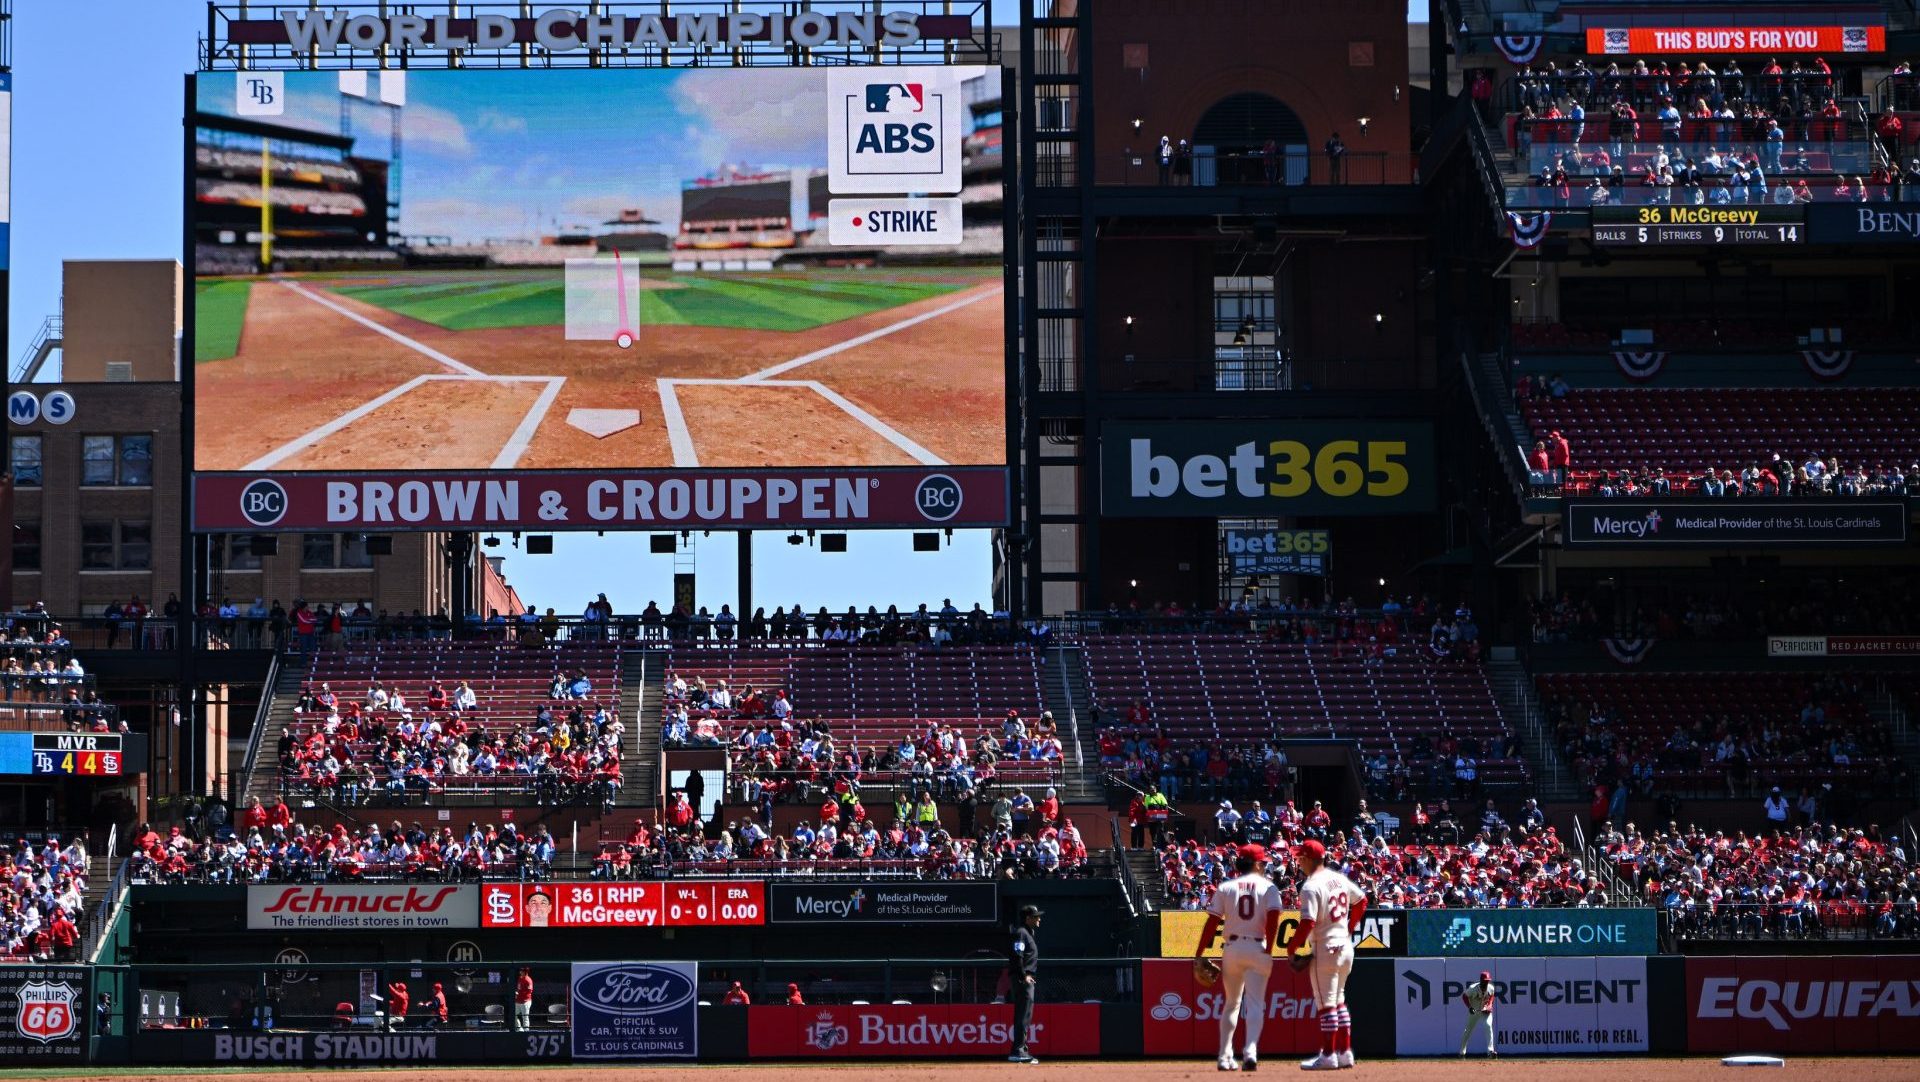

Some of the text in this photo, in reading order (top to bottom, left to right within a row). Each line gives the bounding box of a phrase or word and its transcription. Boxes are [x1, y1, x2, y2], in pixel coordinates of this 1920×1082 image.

[281, 9, 920, 51] WORLD CHAMPIONS
[1654, 30, 1818, 50] THIS BUD'S FOR YOU
[247, 79, 274, 105] TB
[856, 122, 935, 154] ABS
[868, 210, 937, 233] STRIKE
[1639, 207, 1758, 225] 36 McGreevy
[1596, 227, 1797, 243] BALLS 5 STRIKES 9 TOTAL 14
[1130, 438, 1409, 498] bet365
[327, 480, 519, 522] BROWN
[537, 490, 569, 521] &
[1594, 516, 1647, 538] Mercy
[1676, 516, 1881, 529] Medical Provider of the St. Louis Cardinals
[1227, 531, 1329, 554] bet365
[1263, 555, 1293, 564] BRIDGE
[1831, 642, 1850, 650] RED
[1853, 641, 1891, 650] JACKET
[57, 736, 97, 750] MVR
[33, 752, 54, 773] TB
[61, 752, 74, 774] 4
[84, 752, 97, 774] 4
[571, 887, 645, 903] 36 RHP
[678, 889, 698, 900] W-L
[727, 889, 748, 899] ERA
[877, 893, 948, 902] Medical Provider
[563, 905, 657, 926] McGreevy
[721, 904, 758, 919] 0.00
[796, 896, 851, 917] Mercy
[877, 905, 886, 914] of
[887, 905, 901, 914] the
[934, 904, 972, 914] Cardinals
[1327, 892, 1348, 922] 29
[272, 914, 449, 927] The friendliest stores in town
[26, 991, 68, 1001] PHILLIPS
[598, 971, 670, 1003] Ford
[1443, 980, 1641, 1005] PRFICIENT
[28, 1006, 64, 1029] 66
[613, 1018, 656, 1026] OFFICIAL
[591, 1027, 678, 1036] CAR, TRUCK & SUV
[1512, 1030, 1584, 1045] CONSULTING.
[1587, 1030, 1609, 1044] FOR
[1612, 1029, 1643, 1044] REAL.
[215, 1034, 437, 1060] BUSCH STADIUM
[584, 1041, 684, 1051] ST. LOUIS CARDINALS
